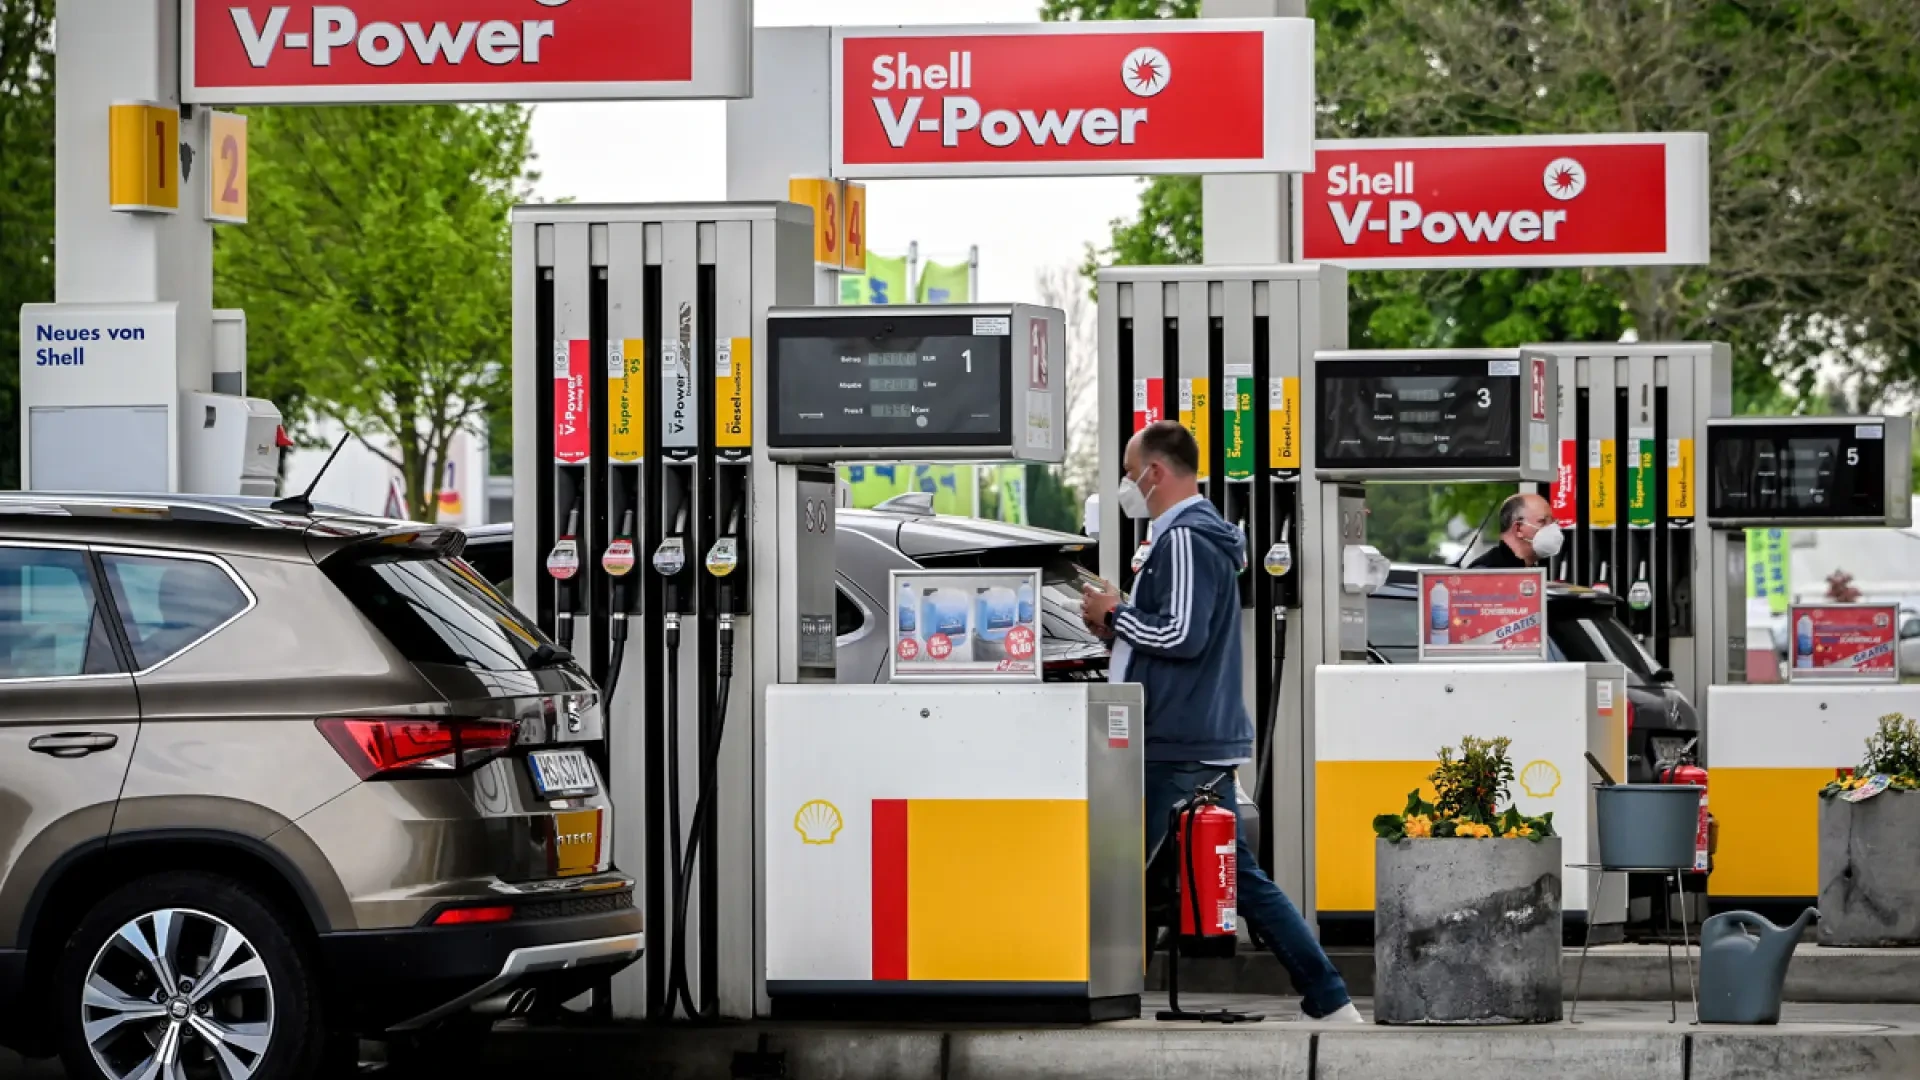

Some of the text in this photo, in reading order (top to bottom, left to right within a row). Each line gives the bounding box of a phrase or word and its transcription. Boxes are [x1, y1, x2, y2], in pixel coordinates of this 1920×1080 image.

[231, 5, 554, 67] V-Power
[872, 51, 971, 90] Shell
[872, 96, 1147, 148] V-Power
[154, 119, 165, 189] 1
[220, 134, 239, 204] 2
[1326, 161, 1414, 196] Shell
[824, 194, 836, 253] 3
[848, 199, 862, 256] 4
[1327, 200, 1566, 245] V-Power
[36, 325, 145, 342] Neues von
[36, 348, 84, 367] Shell
[630, 358, 640, 374] 95
[961, 349, 972, 373] 1
[565, 374, 576, 435] V-Power
[618, 396, 632, 435] Super
[674, 373, 685, 434] V-Power
[731, 397, 741, 434] Diesel
[1477, 387, 1492, 408] 3
[1231, 424, 1243, 458] Super
[1283, 428, 1292, 458] Diesel
[1846, 447, 1859, 465] 5
[1558, 464, 1566, 508] V-Power
[1635, 480, 1645, 508] Super
[1495, 614, 1537, 638] GRATIS
[1853, 643, 1889, 662] GRATIS
